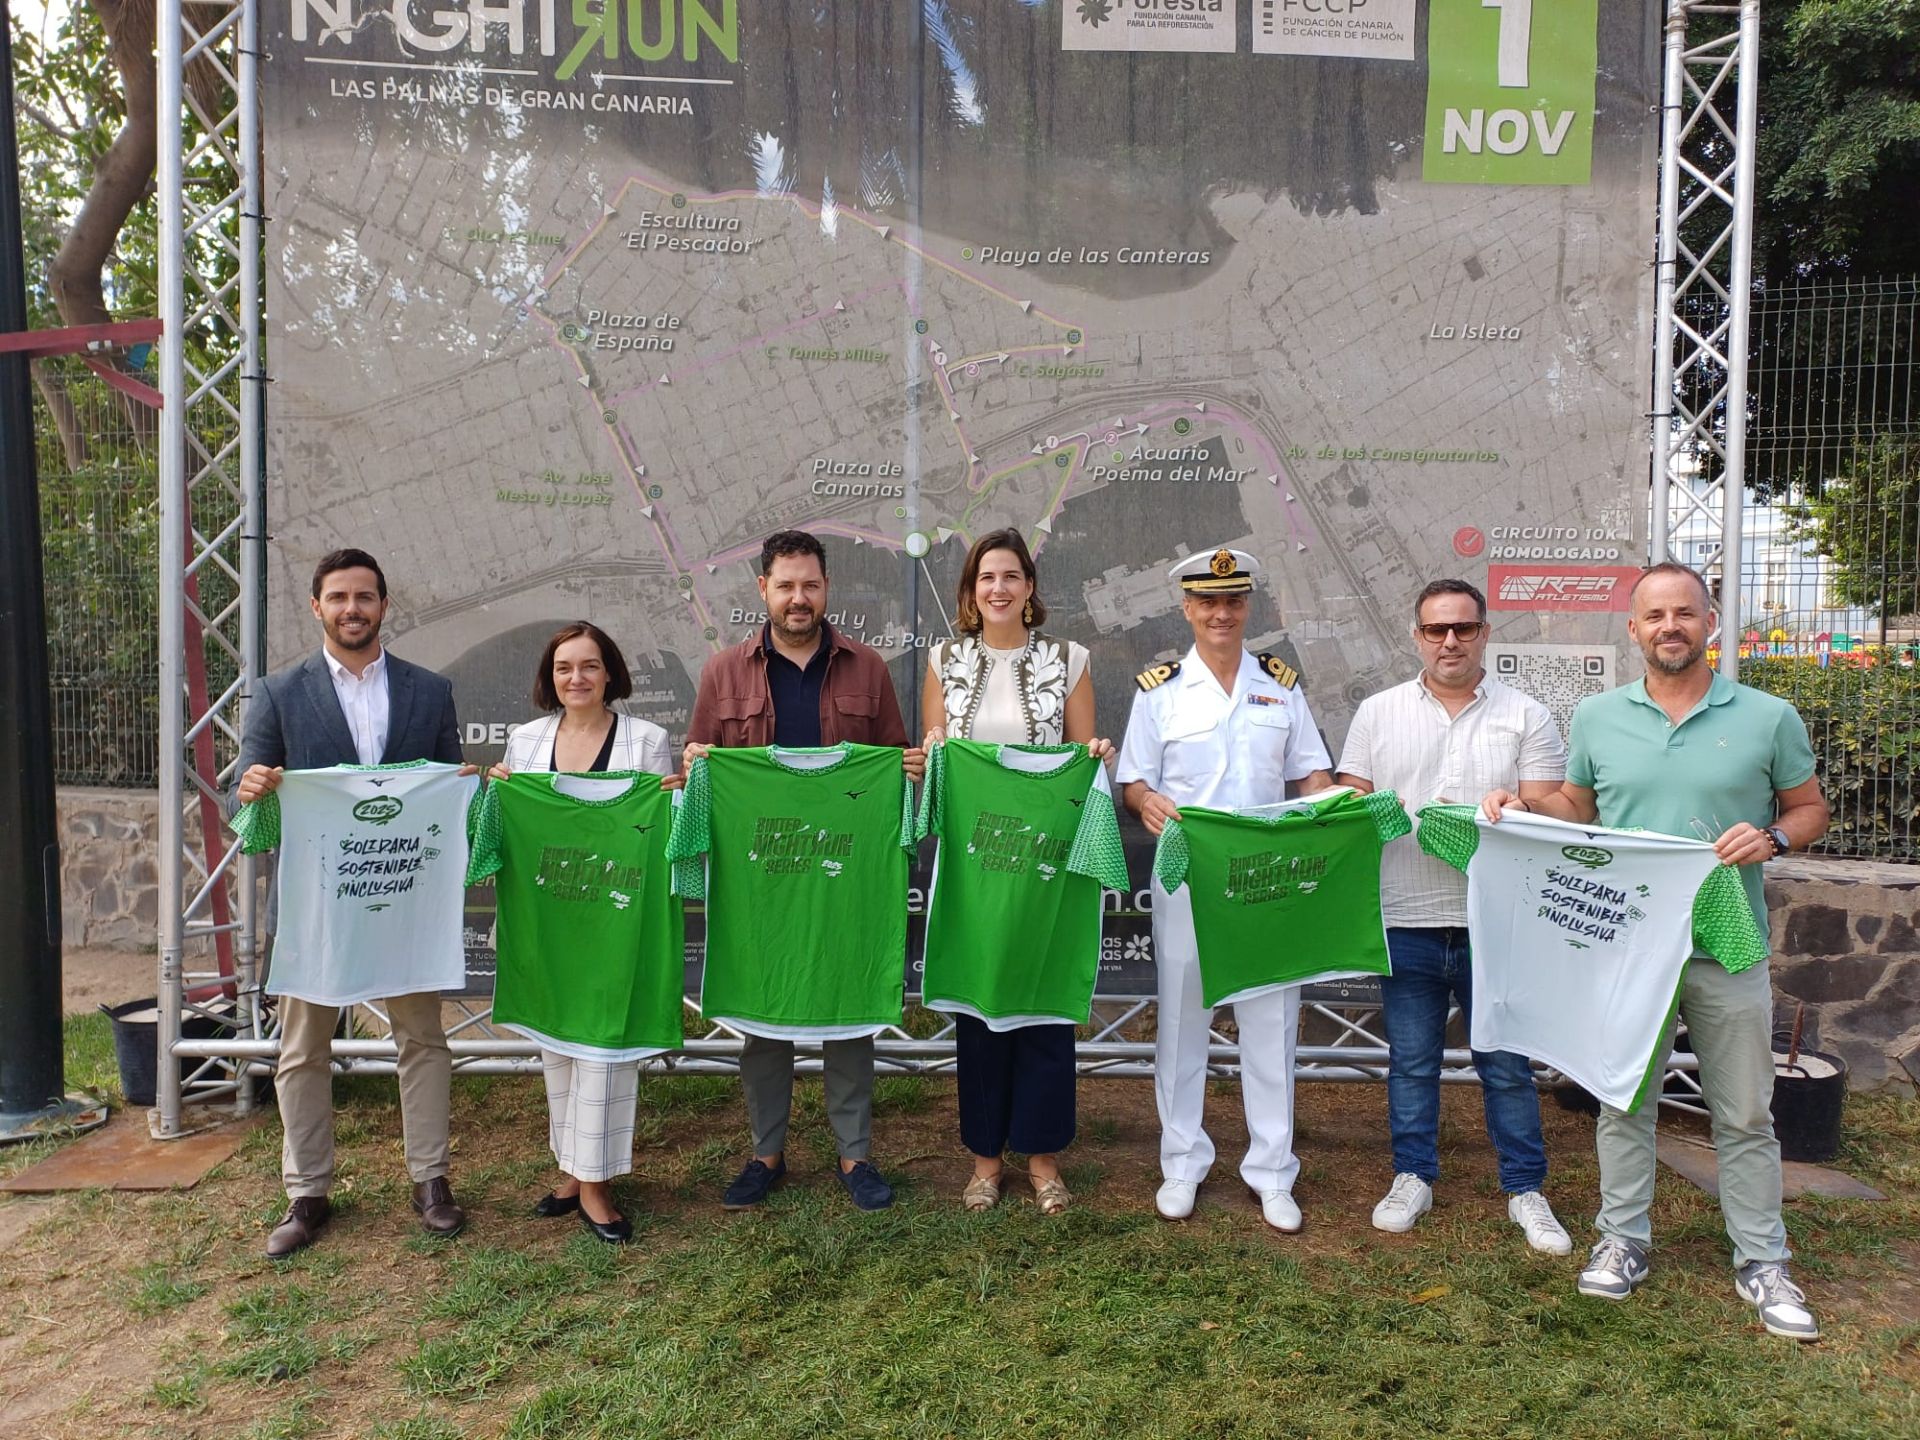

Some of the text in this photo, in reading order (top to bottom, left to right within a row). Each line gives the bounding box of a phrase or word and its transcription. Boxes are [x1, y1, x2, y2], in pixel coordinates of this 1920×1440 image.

[1147, 20, 1157, 28] LA
[1158, 20, 1214, 30] REFORESTACIÓN
[1175, 13, 1206, 21] CANARIA
[1282, 17, 1393, 29] FUNDACIÓN CANARIA
[1282, 28, 1404, 41] DE CÁNCER DE PULMÓN
[330, 78, 694, 115] LAS PALMAS DE GRAN CANARIA
[1443, 108, 1576, 155] NOV
[640, 211, 741, 231] Escultura
[980, 246, 1211, 266] Playa de las Canteras
[587, 310, 680, 329] Plaza de
[1430, 322, 1521, 341] La Isleta
[594, 333, 674, 352] España
[843, 348, 890, 362] Miller
[1037, 366, 1104, 380] Sagasta
[1129, 446, 1210, 461] Acuario
[1316, 444, 1337, 459] de
[1341, 444, 1365, 460] los
[1370, 447, 1499, 465] Consignatarios
[813, 459, 902, 476] Plaza de
[1169, 465, 1200, 482] del
[496, 488, 539, 502] Mesa
[544, 493, 556, 505] y
[812, 480, 904, 497] Canarias
[1491, 526, 1619, 541] CIRCUITO 10K
[1490, 546, 1619, 560] HOMOLOGADO
[1541, 576, 1618, 593] RFEA
[1535, 593, 1610, 601] ATLETISMO
[853, 612, 867, 628] y
[860, 632, 893, 647] Las
[361, 804, 396, 815] 2025
[342, 837, 420, 856] SOLIDARIA
[1569, 849, 1606, 861] 2025
[338, 857, 423, 878] SOSTENIBLE
[344, 876, 415, 898] INCLUSIVA
[1547, 872, 1627, 906] SOLIDARIA
[1541, 889, 1628, 925] SOSTENIBLE
[1545, 907, 1616, 943] INCLUSIVA
